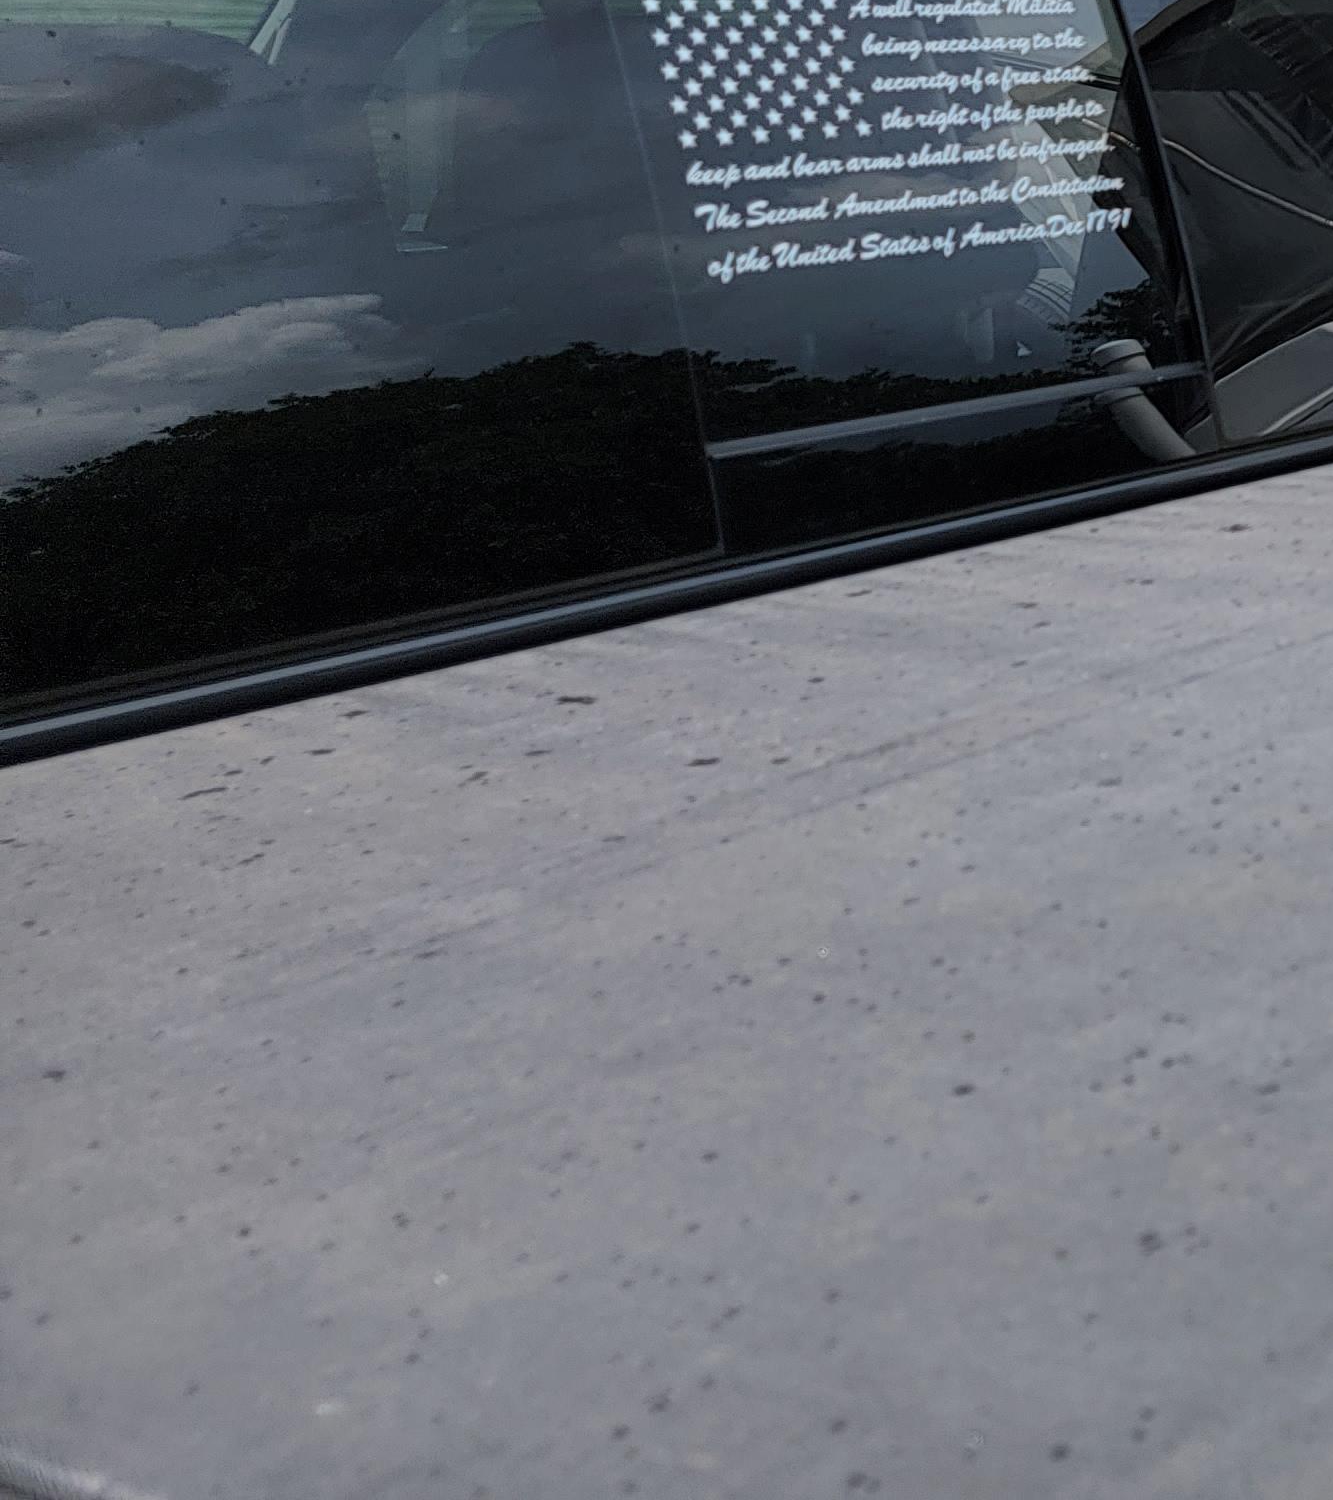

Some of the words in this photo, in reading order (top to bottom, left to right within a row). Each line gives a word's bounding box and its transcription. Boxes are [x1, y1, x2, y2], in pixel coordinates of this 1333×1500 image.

[862, 33, 923, 61] being
[925, 36, 1031, 55] necessary
[1032, 33, 1054, 50] to
[1054, 27, 1086, 48] the
[871, 71, 958, 94] security
[960, 67, 984, 94] of
[985, 71, 1000, 86] a
[1000, 66, 1042, 92] free
[882, 107, 915, 131] the
[915, 103, 968, 134] right
[970, 104, 994, 131] of
[993, 100, 1023, 122] the
[1025, 98, 1085, 126] people
[1085, 99, 1105, 116] to
[686, 161, 743, 190] keep
[744, 156, 792, 181] and
[793, 152, 843, 177] bear
[846, 153, 905, 172] arms
[907, 142, 962, 168] shall
[962, 145, 997, 162] not
[996, 138, 1018, 162] be
[695, 203, 743, 233] The
[745, 199, 831, 228] Second
[833, 188, 960, 220] Amendment
[958, 186, 981, 207] to
[979, 179, 1010, 203] the
[1010, 175, 1126, 205] Constitution
[707, 251, 736, 284] of
[735, 246, 773, 274] the
[771, 241, 857, 268] United
[859, 232, 931, 260] States
[932, 226, 956, 258] of
[1085, 206, 1133, 234] 1791
